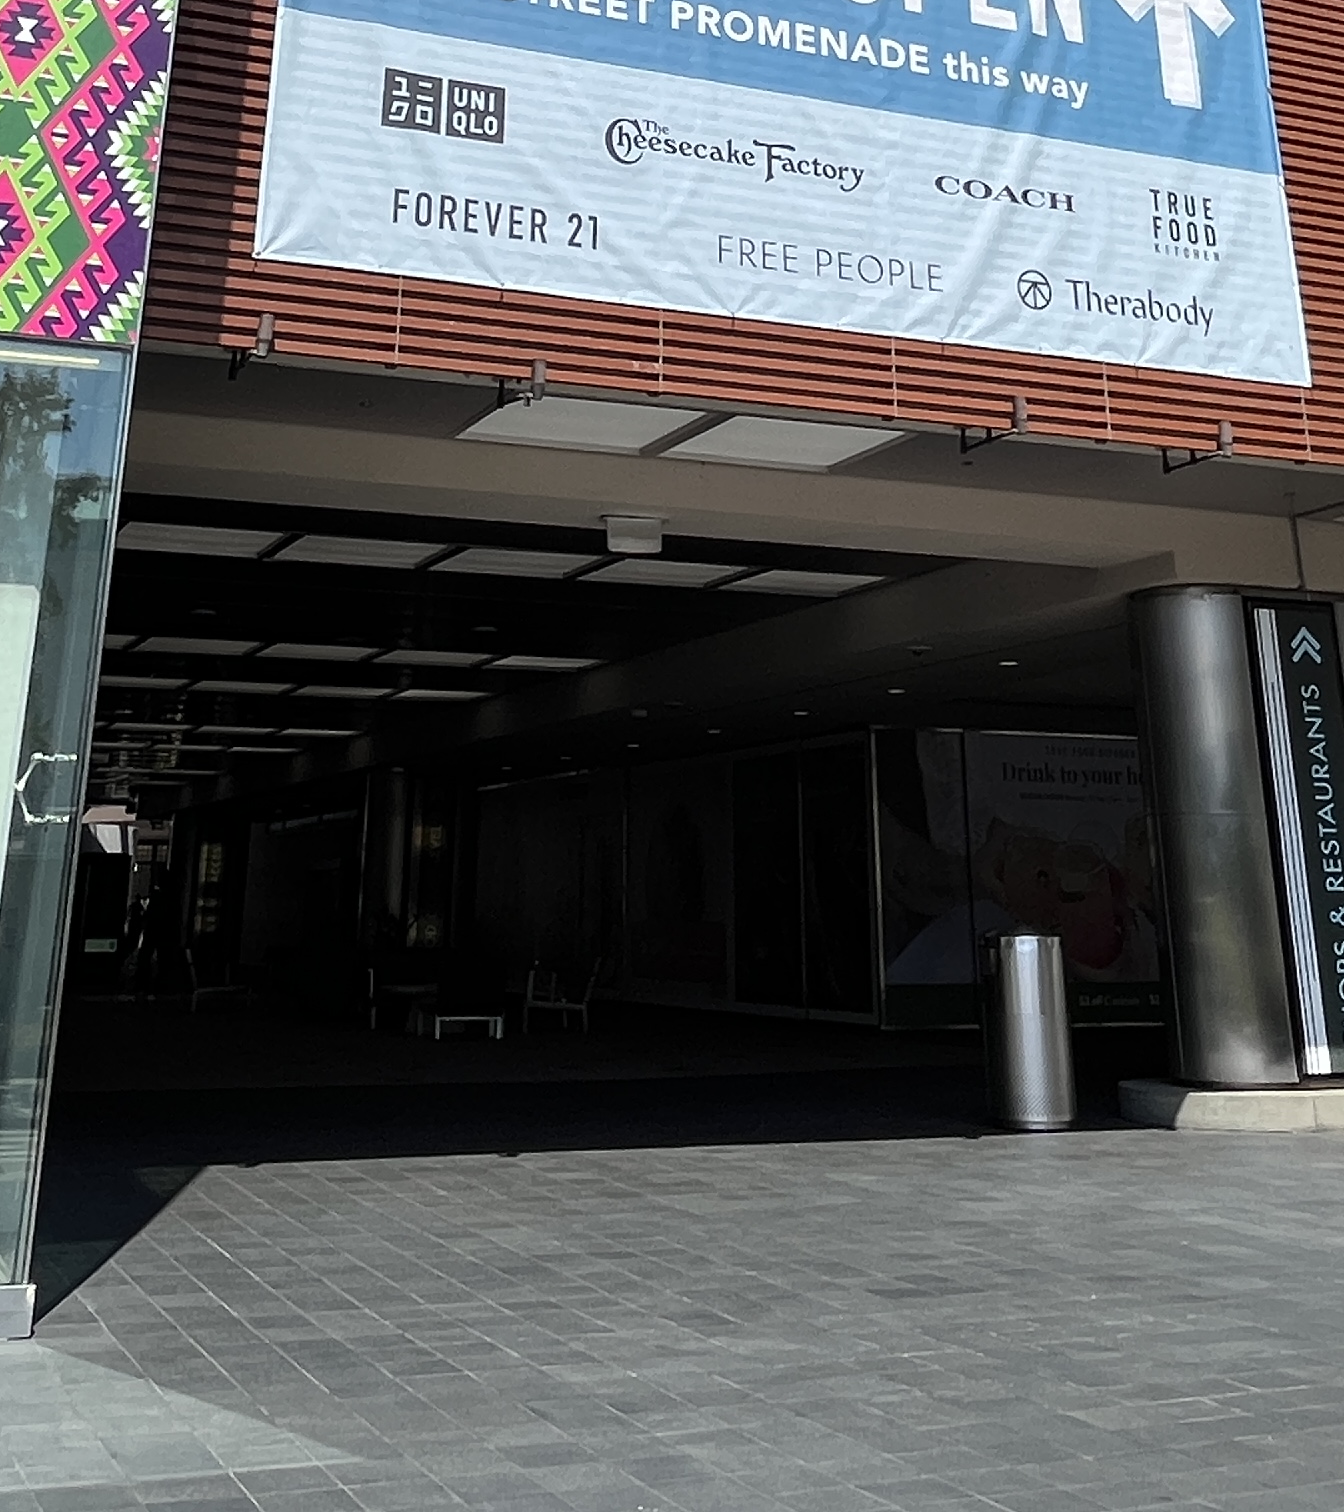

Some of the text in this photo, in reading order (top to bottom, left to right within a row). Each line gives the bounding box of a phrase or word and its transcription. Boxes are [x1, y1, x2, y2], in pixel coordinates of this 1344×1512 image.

[670, 0, 931, 76] PROMENADE
[943, 50, 1010, 90] this
[1020, 70, 1090, 110] way
[605, 118, 865, 192] Cheesecake Factory
[642, 119, 669, 136] The
[392, 189, 600, 250] FOREVER 21
[934, 174, 1077, 213] COACH
[1149, 189, 1214, 221] TRUE
[1153, 216, 1216, 246] FOOD
[717, 234, 944, 292] FREE PEOPLE
[1065, 279, 1215, 337] Therabody
